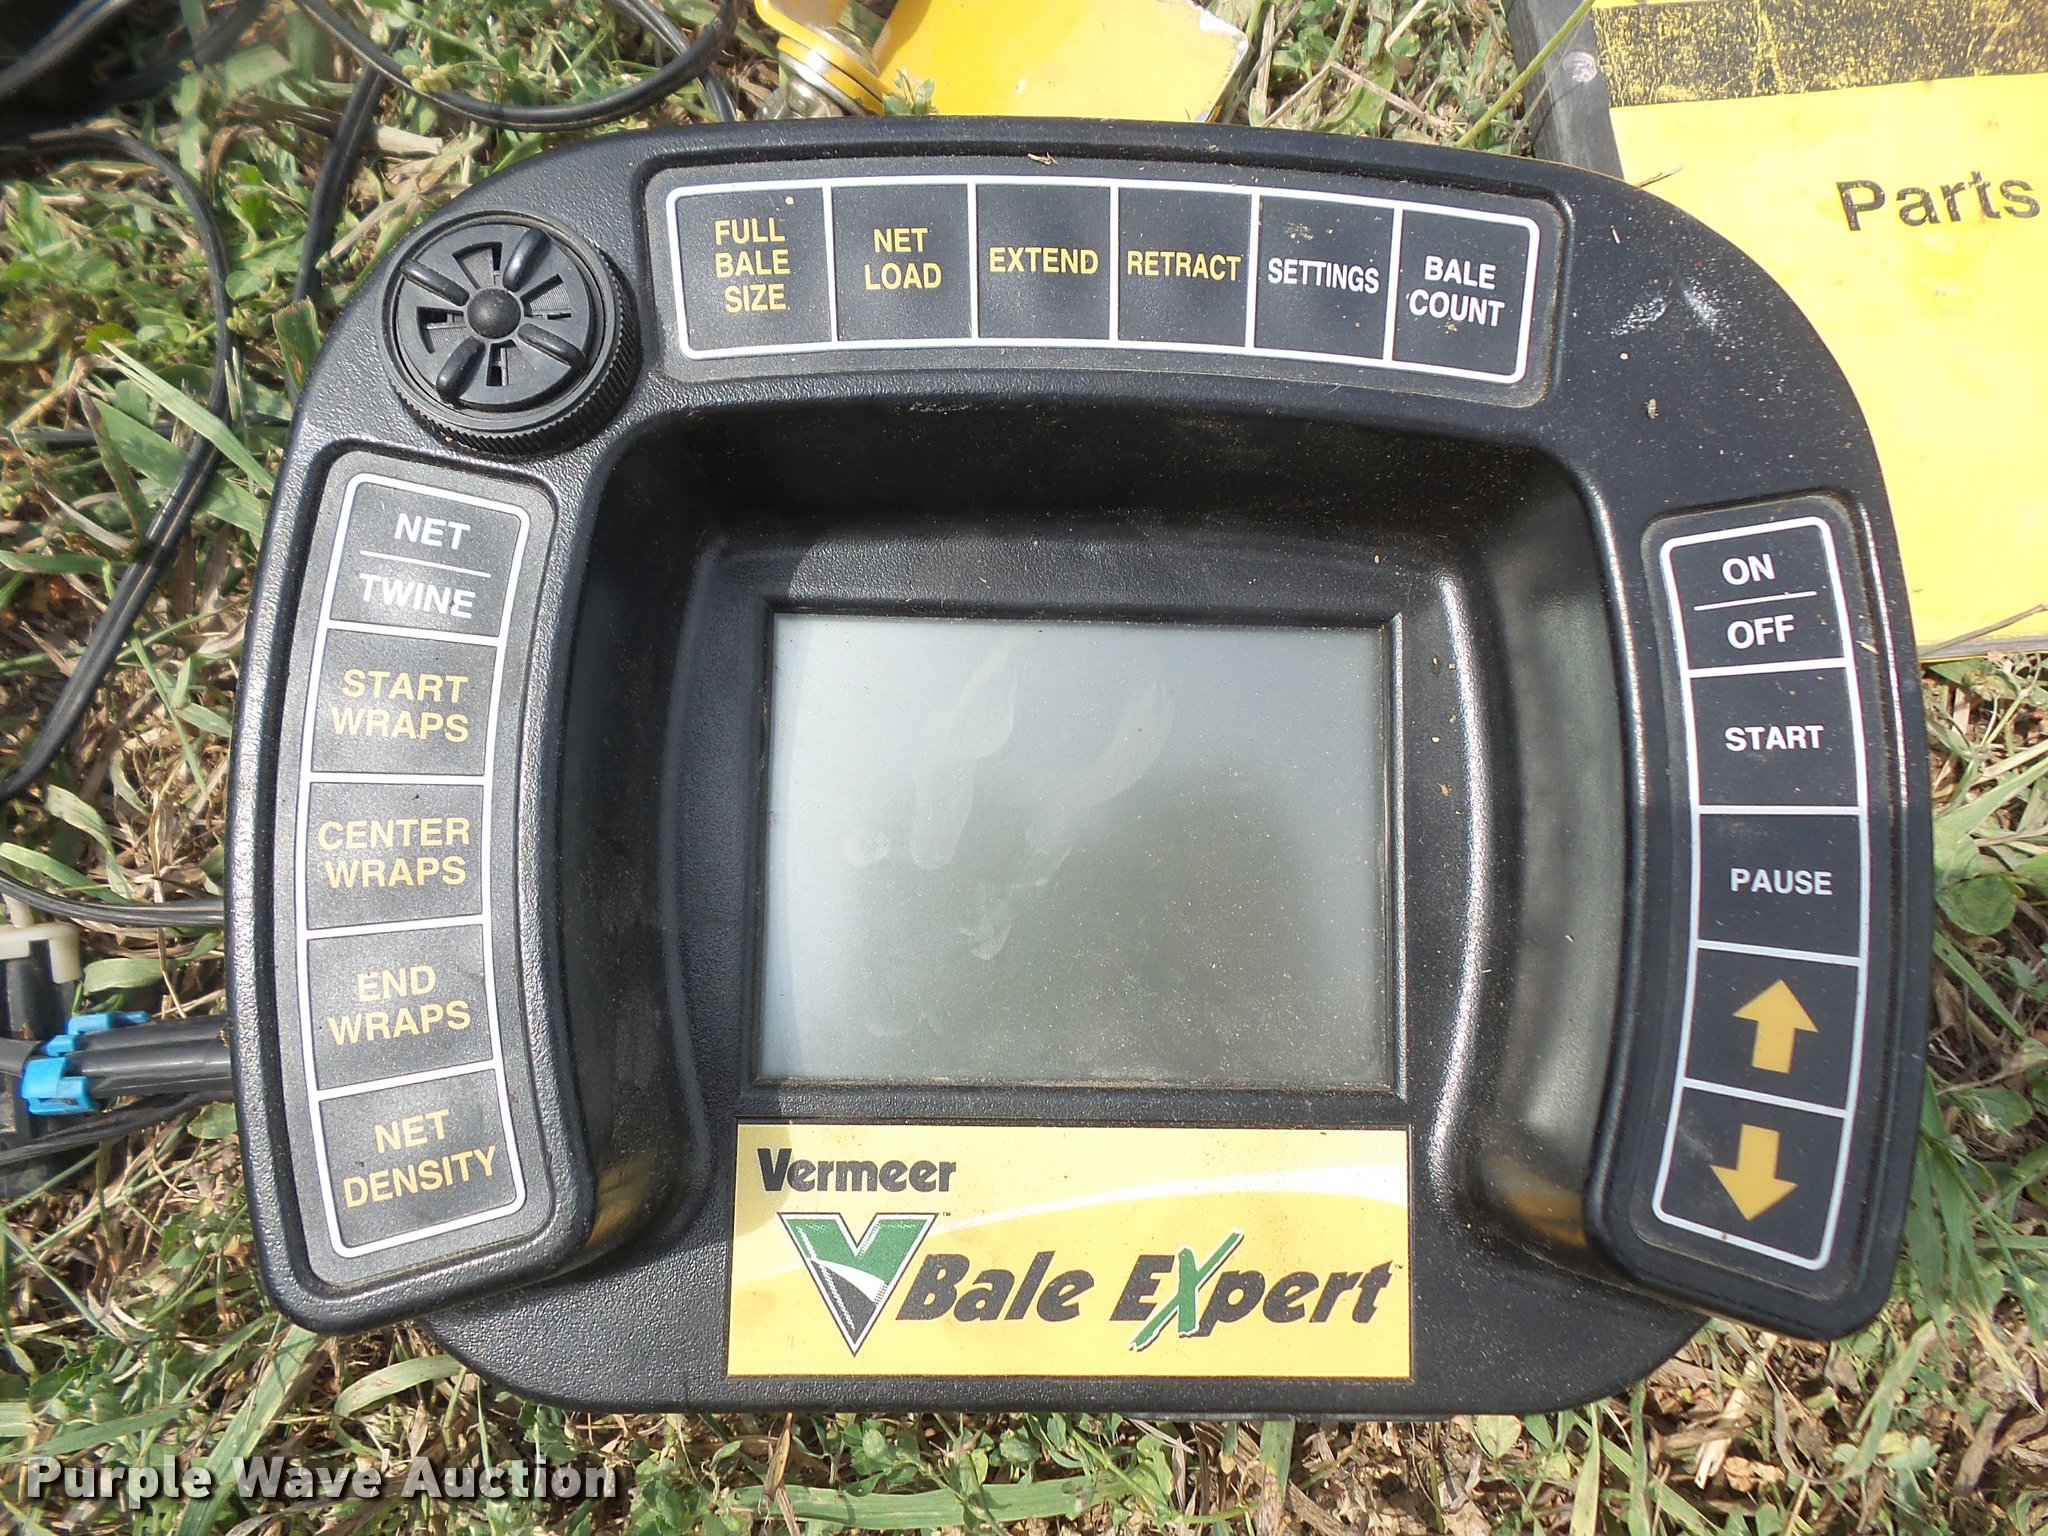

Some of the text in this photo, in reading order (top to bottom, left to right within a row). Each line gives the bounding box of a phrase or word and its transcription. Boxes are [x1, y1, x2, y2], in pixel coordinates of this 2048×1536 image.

[1836, 171, 2041, 231] Parts
[714, 217, 786, 248] FULL
[874, 227, 929, 254] NET
[714, 249, 792, 279] BALE
[864, 261, 942, 292] LOAD
[989, 246, 1100, 276] EXTEND
[1126, 250, 1241, 283] RETRACT
[1267, 257, 1381, 296] SETTINGS
[1424, 256, 1497, 291] BALE
[724, 282, 787, 314] SIZE
[1408, 289, 1506, 329] COUNT
[394, 513, 471, 550] NET
[1721, 553, 1776, 586] ON
[359, 573, 476, 619] TWINE
[1726, 614, 1795, 650] OFF
[342, 668, 469, 704] START
[330, 707, 469, 743] WRAPS
[1724, 724, 1824, 752] START
[318, 817, 470, 851] CENTER
[325, 856, 467, 889] WRAPS
[1730, 868, 1833, 896] PAUSE
[357, 965, 436, 1002] END
[329, 1000, 472, 1046] WRAPS
[375, 1109, 450, 1154] NET
[343, 1145, 496, 1209] DENSITY
[756, 1148, 956, 1193] Vermeer
[895, 1250, 1094, 1322] Bale
